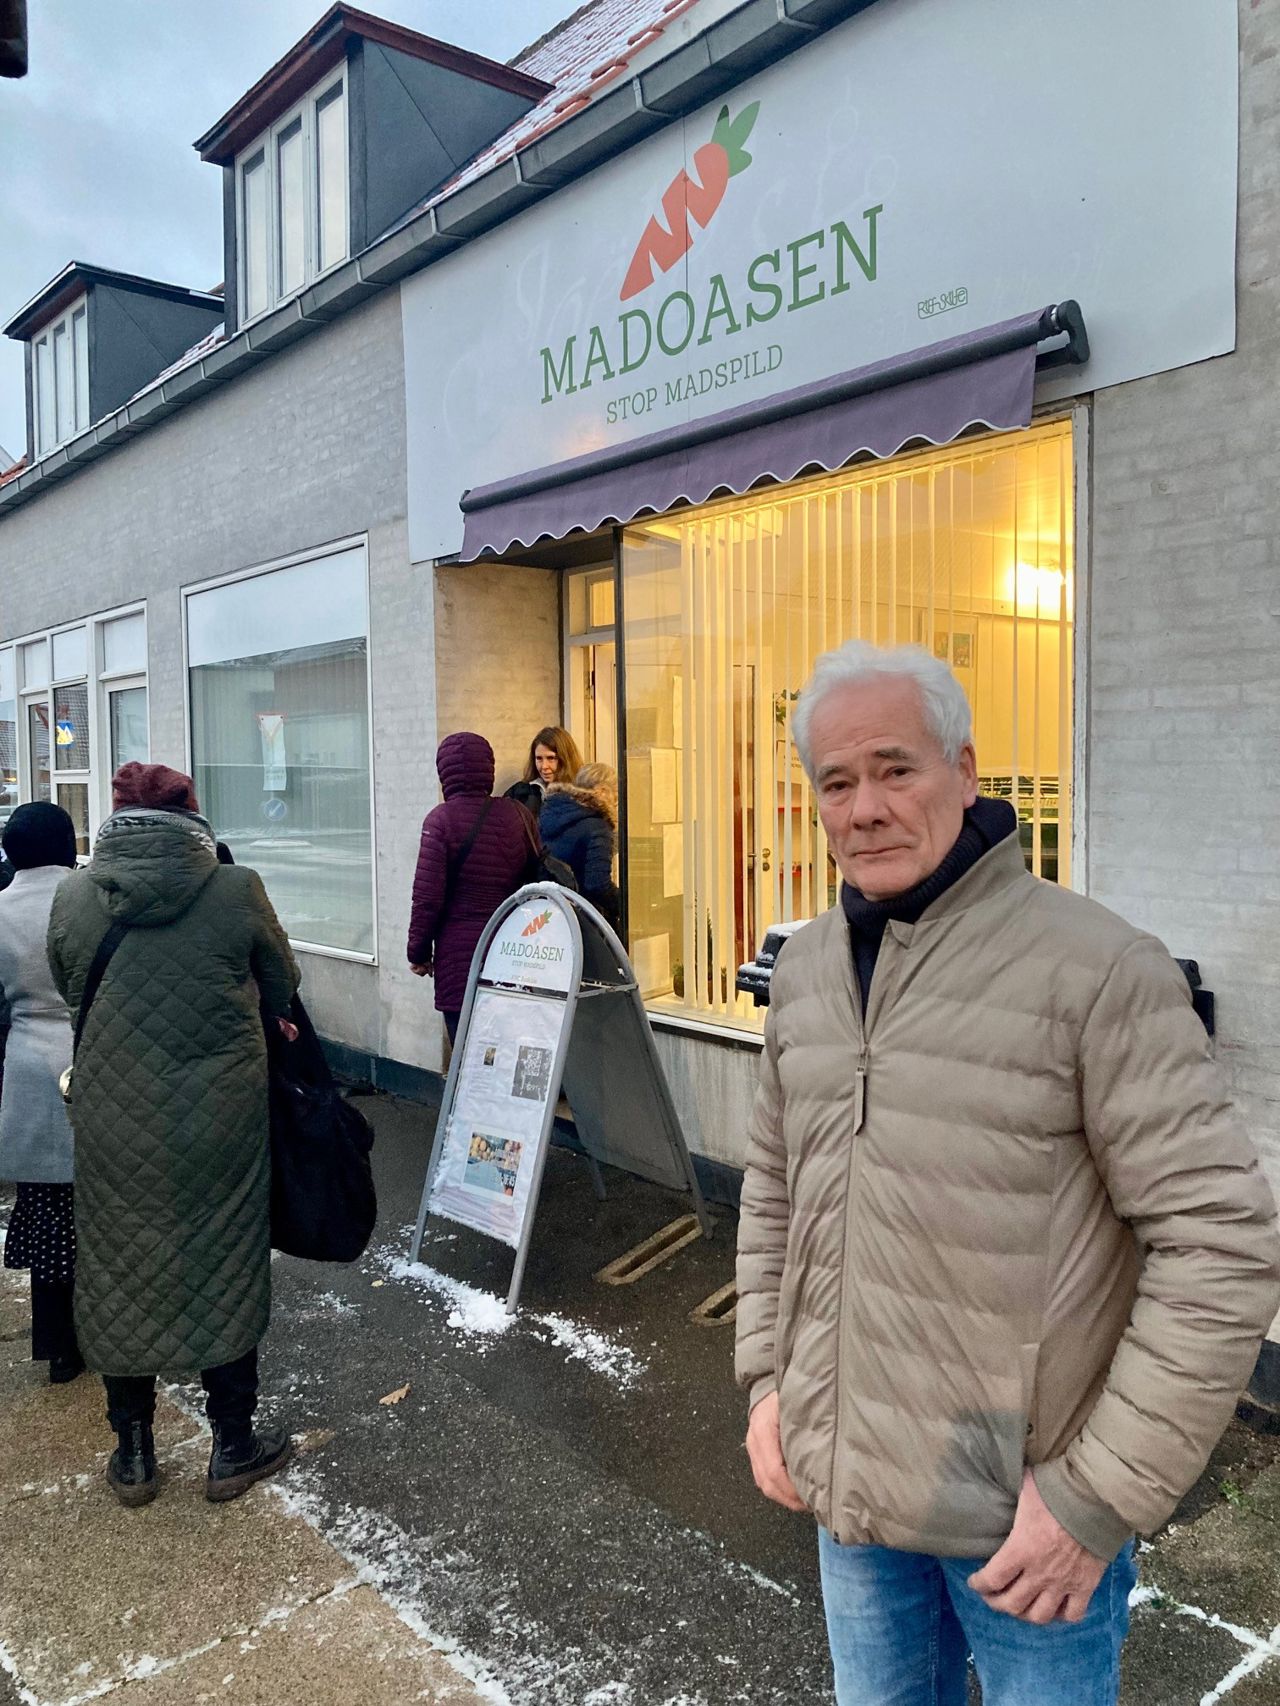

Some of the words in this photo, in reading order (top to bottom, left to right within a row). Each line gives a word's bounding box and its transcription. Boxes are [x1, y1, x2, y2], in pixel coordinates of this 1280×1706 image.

[540, 204, 884, 405] MADOASEN
[606, 387, 658, 424] STOP
[665, 345, 783, 406] MADSPILD
[500, 941, 564, 962] MADOASEN
